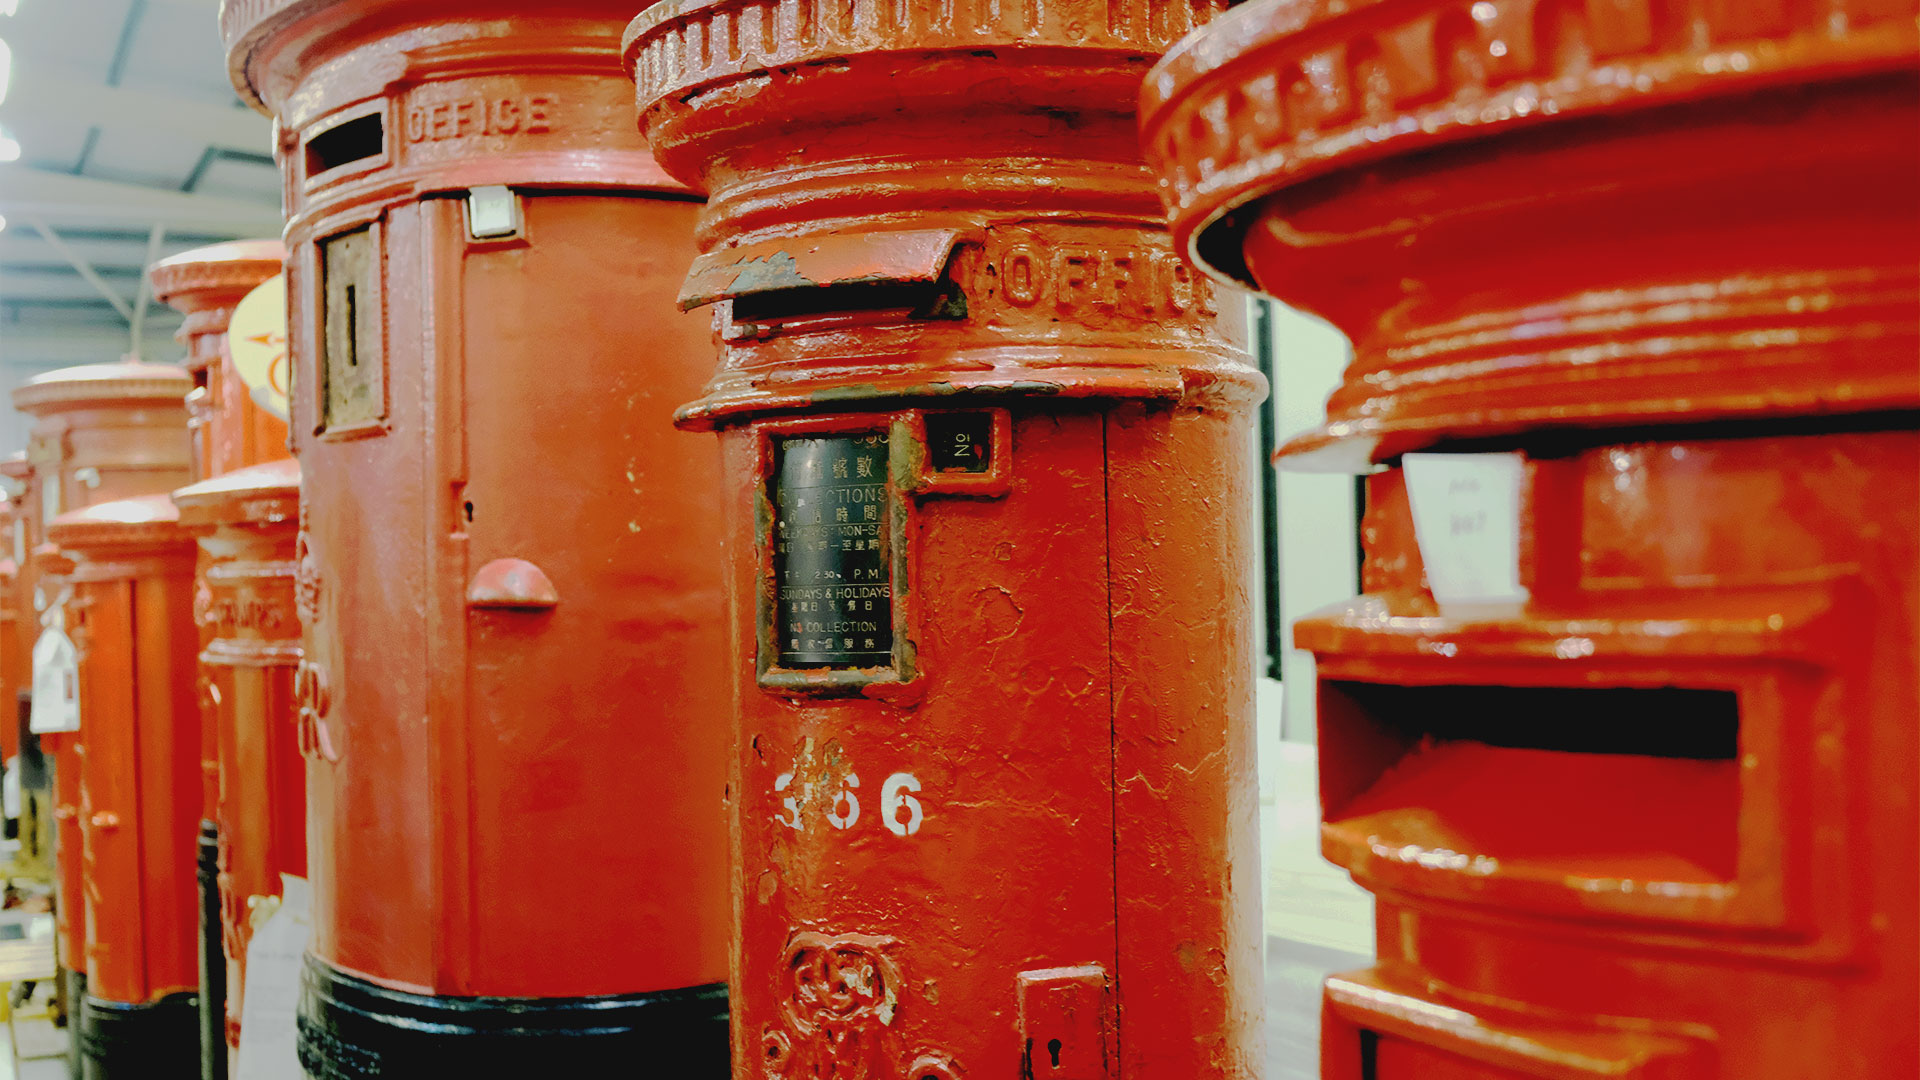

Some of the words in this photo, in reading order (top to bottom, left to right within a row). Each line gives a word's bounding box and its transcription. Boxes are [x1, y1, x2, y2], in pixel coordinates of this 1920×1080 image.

[408, 94, 557, 143] OFFICE
[780, 588, 823, 600] SUNDAYS
[824, 587, 832, 599] &
[836, 586, 890, 599] HOLIDAYS
[806, 621, 877, 633] COLLECTION
[774, 772, 924, 836] 366
